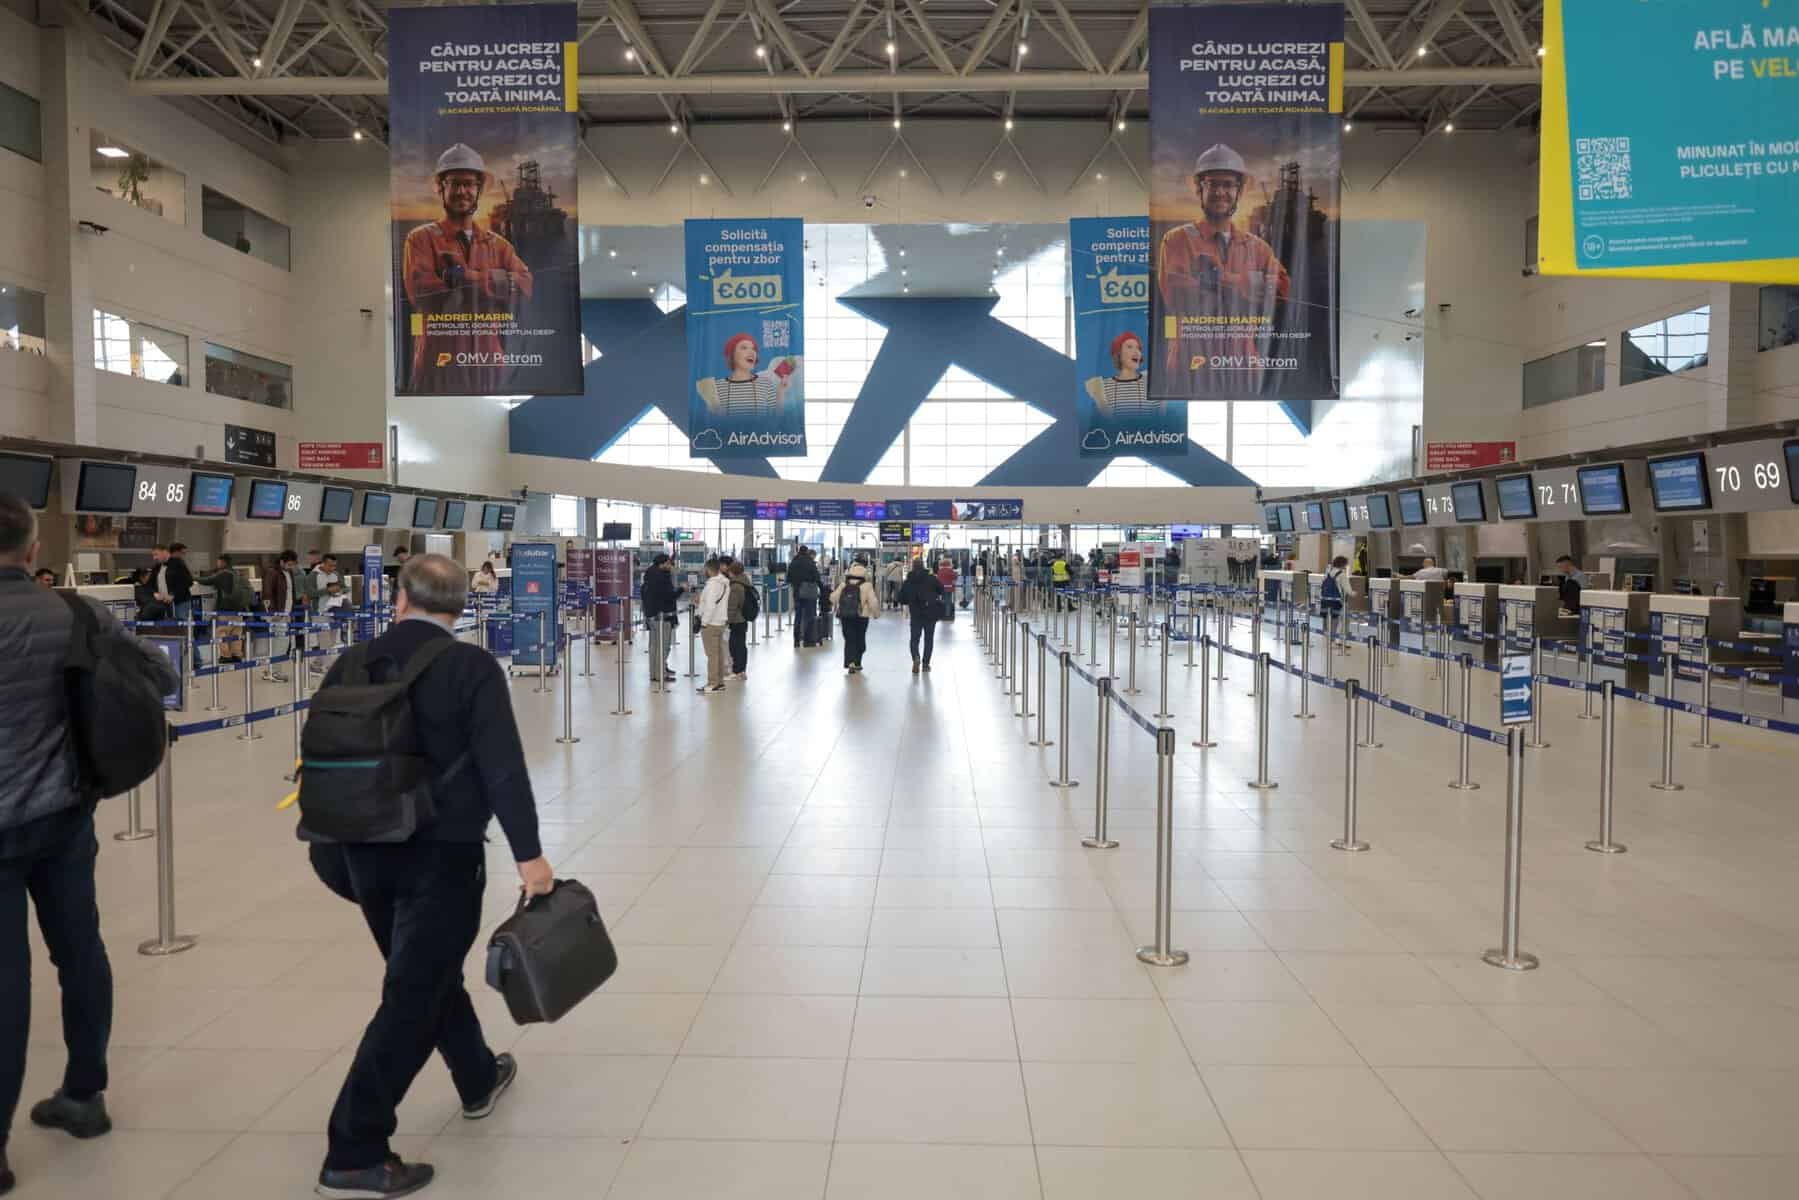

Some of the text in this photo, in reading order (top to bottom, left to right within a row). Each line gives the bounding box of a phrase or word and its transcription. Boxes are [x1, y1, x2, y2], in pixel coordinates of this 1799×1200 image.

[1694, 23, 1757, 50] AFLĂ
[431, 42, 560, 57] CÂND LUCREZI
[1192, 41, 1325, 56] CÂND LUCREZI
[419, 56, 561, 72] PENTRU ACASĂ,
[1180, 56, 1325, 72] PENTRU ACASĂ,
[1713, 57, 1799, 80] PE VEL
[457, 74, 561, 87] LUCREZI CU
[1218, 74, 1325, 87] LUCREZI CU
[445, 88, 561, 103] TOATĂ INIMA.
[1206, 88, 1325, 103] TOATĂ INIMA.
[1677, 144, 1746, 159] MINUNAT
[1766, 161, 1788, 174] CU
[721, 229, 768, 240] Solicită
[705, 242, 784, 255] compensația
[709, 254, 781, 265] pentru zbor
[1096, 254, 1135, 265] pentru
[718, 281, 777, 298] €600
[1104, 281, 1146, 297] €60
[427, 313, 513, 322] ANDREI MARIN
[1183, 315, 1271, 325] ANDREI MARIN
[456, 352, 543, 364] OMV Petrom
[1210, 356, 1298, 368] OMV Petrom
[727, 431, 803, 445] AirAdvisor
[1115, 431, 1184, 445] AirAdvisor
[1716, 466, 1741, 492] 70
[1754, 462, 1780, 489] 69
[138, 481, 157, 501] 84
[166, 483, 184, 502] 85
[1538, 485, 1555, 505] 72
[1561, 483, 1577, 504] 71
[287, 494, 301, 511] 86
[1426, 497, 1454, 513] 74 73
